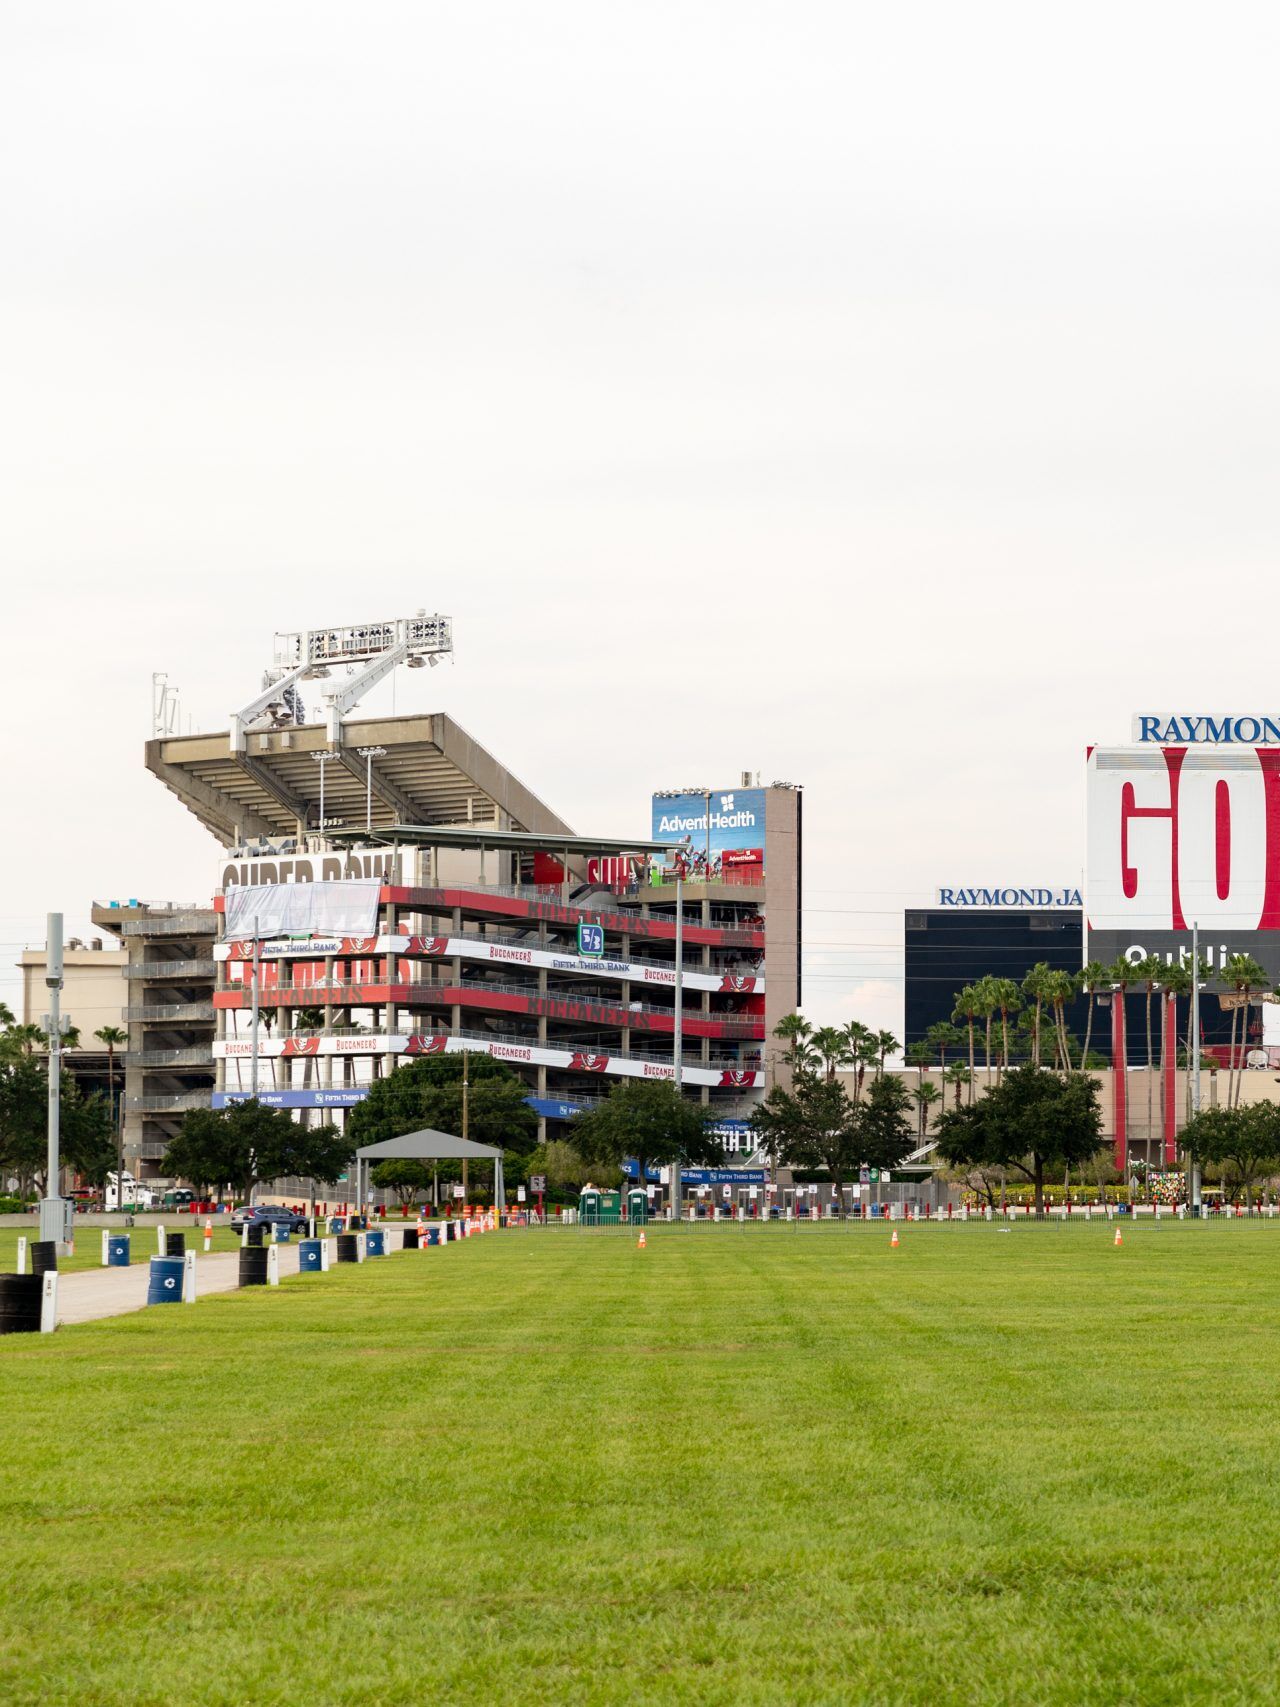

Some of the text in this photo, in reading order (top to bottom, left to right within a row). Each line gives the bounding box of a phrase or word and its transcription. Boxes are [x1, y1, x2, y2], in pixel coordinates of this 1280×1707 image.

[659, 811, 756, 833] AdventHealth
[1087, 747, 1267, 930] GO
[938, 888, 1084, 906] RAYMOND JA
[313, 943, 337, 952] BANK
[489, 946, 532, 963] BUCCANEERS
[552, 959, 631, 972] FIFTH THIRD BANK
[336, 1039, 377, 1051] BUCCANEERS
[489, 1044, 531, 1061] BUCCANEERS
